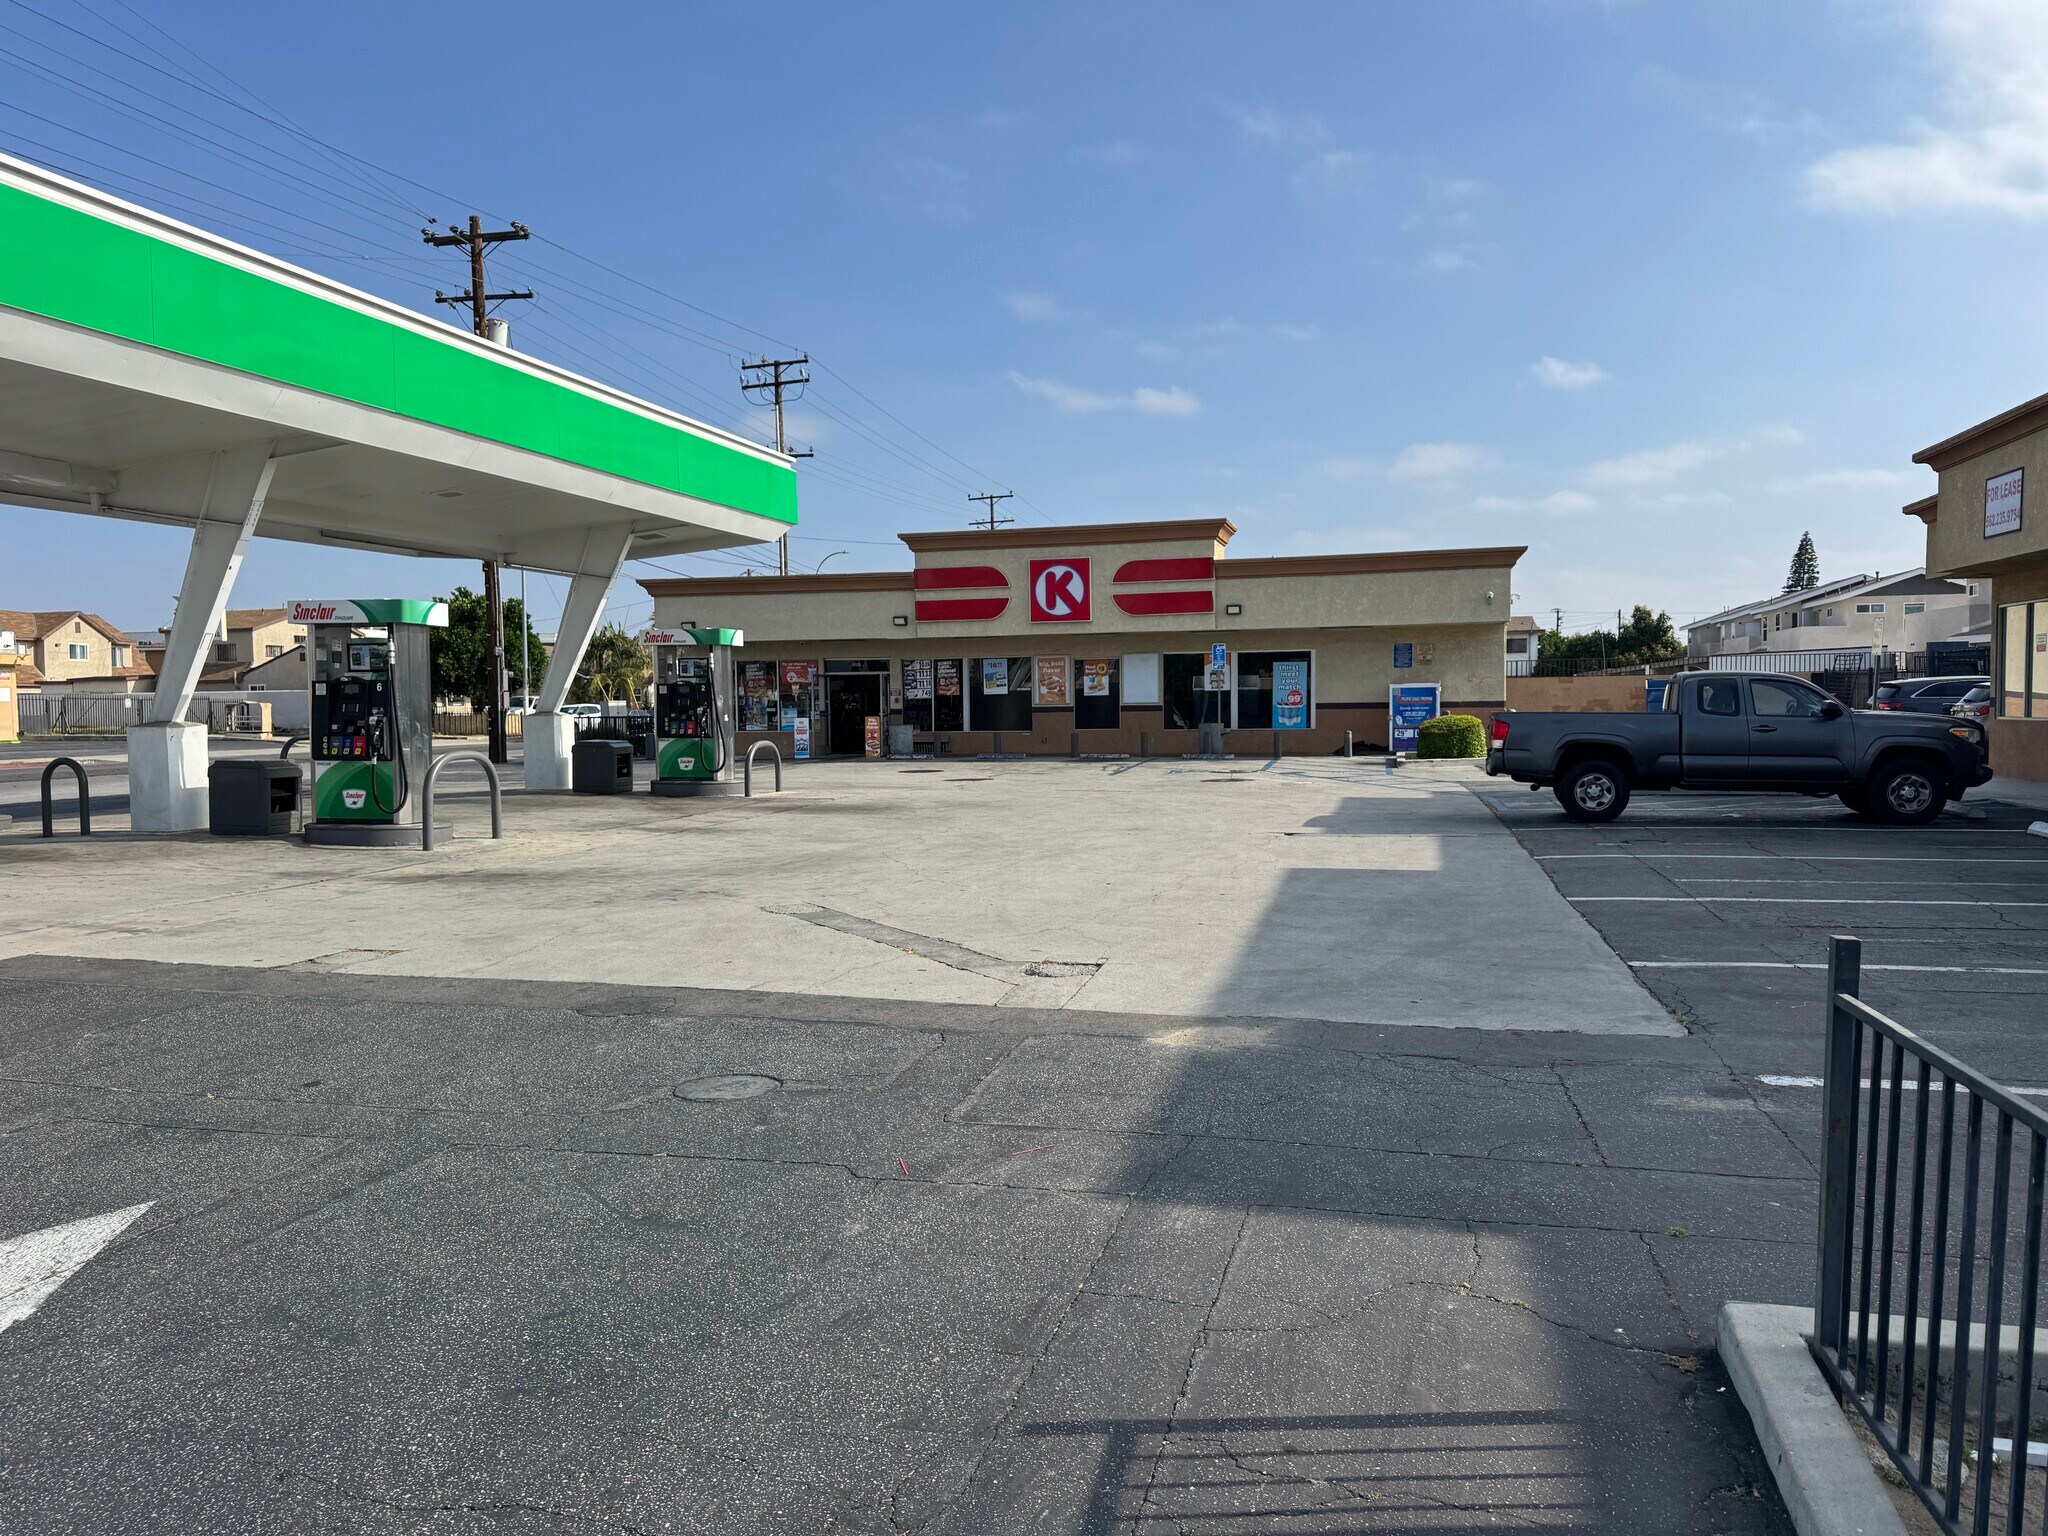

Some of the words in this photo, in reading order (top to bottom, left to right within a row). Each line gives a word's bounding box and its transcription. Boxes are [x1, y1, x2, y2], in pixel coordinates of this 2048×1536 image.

[1986, 486, 1999, 503] FOR
[2000, 478, 2022, 499] LEASE
[1045, 570, 1081, 613] K
[293, 602, 337, 621] Sinclair
[643, 631, 674, 644] Sinclair
[376, 683, 382, 692] 6
